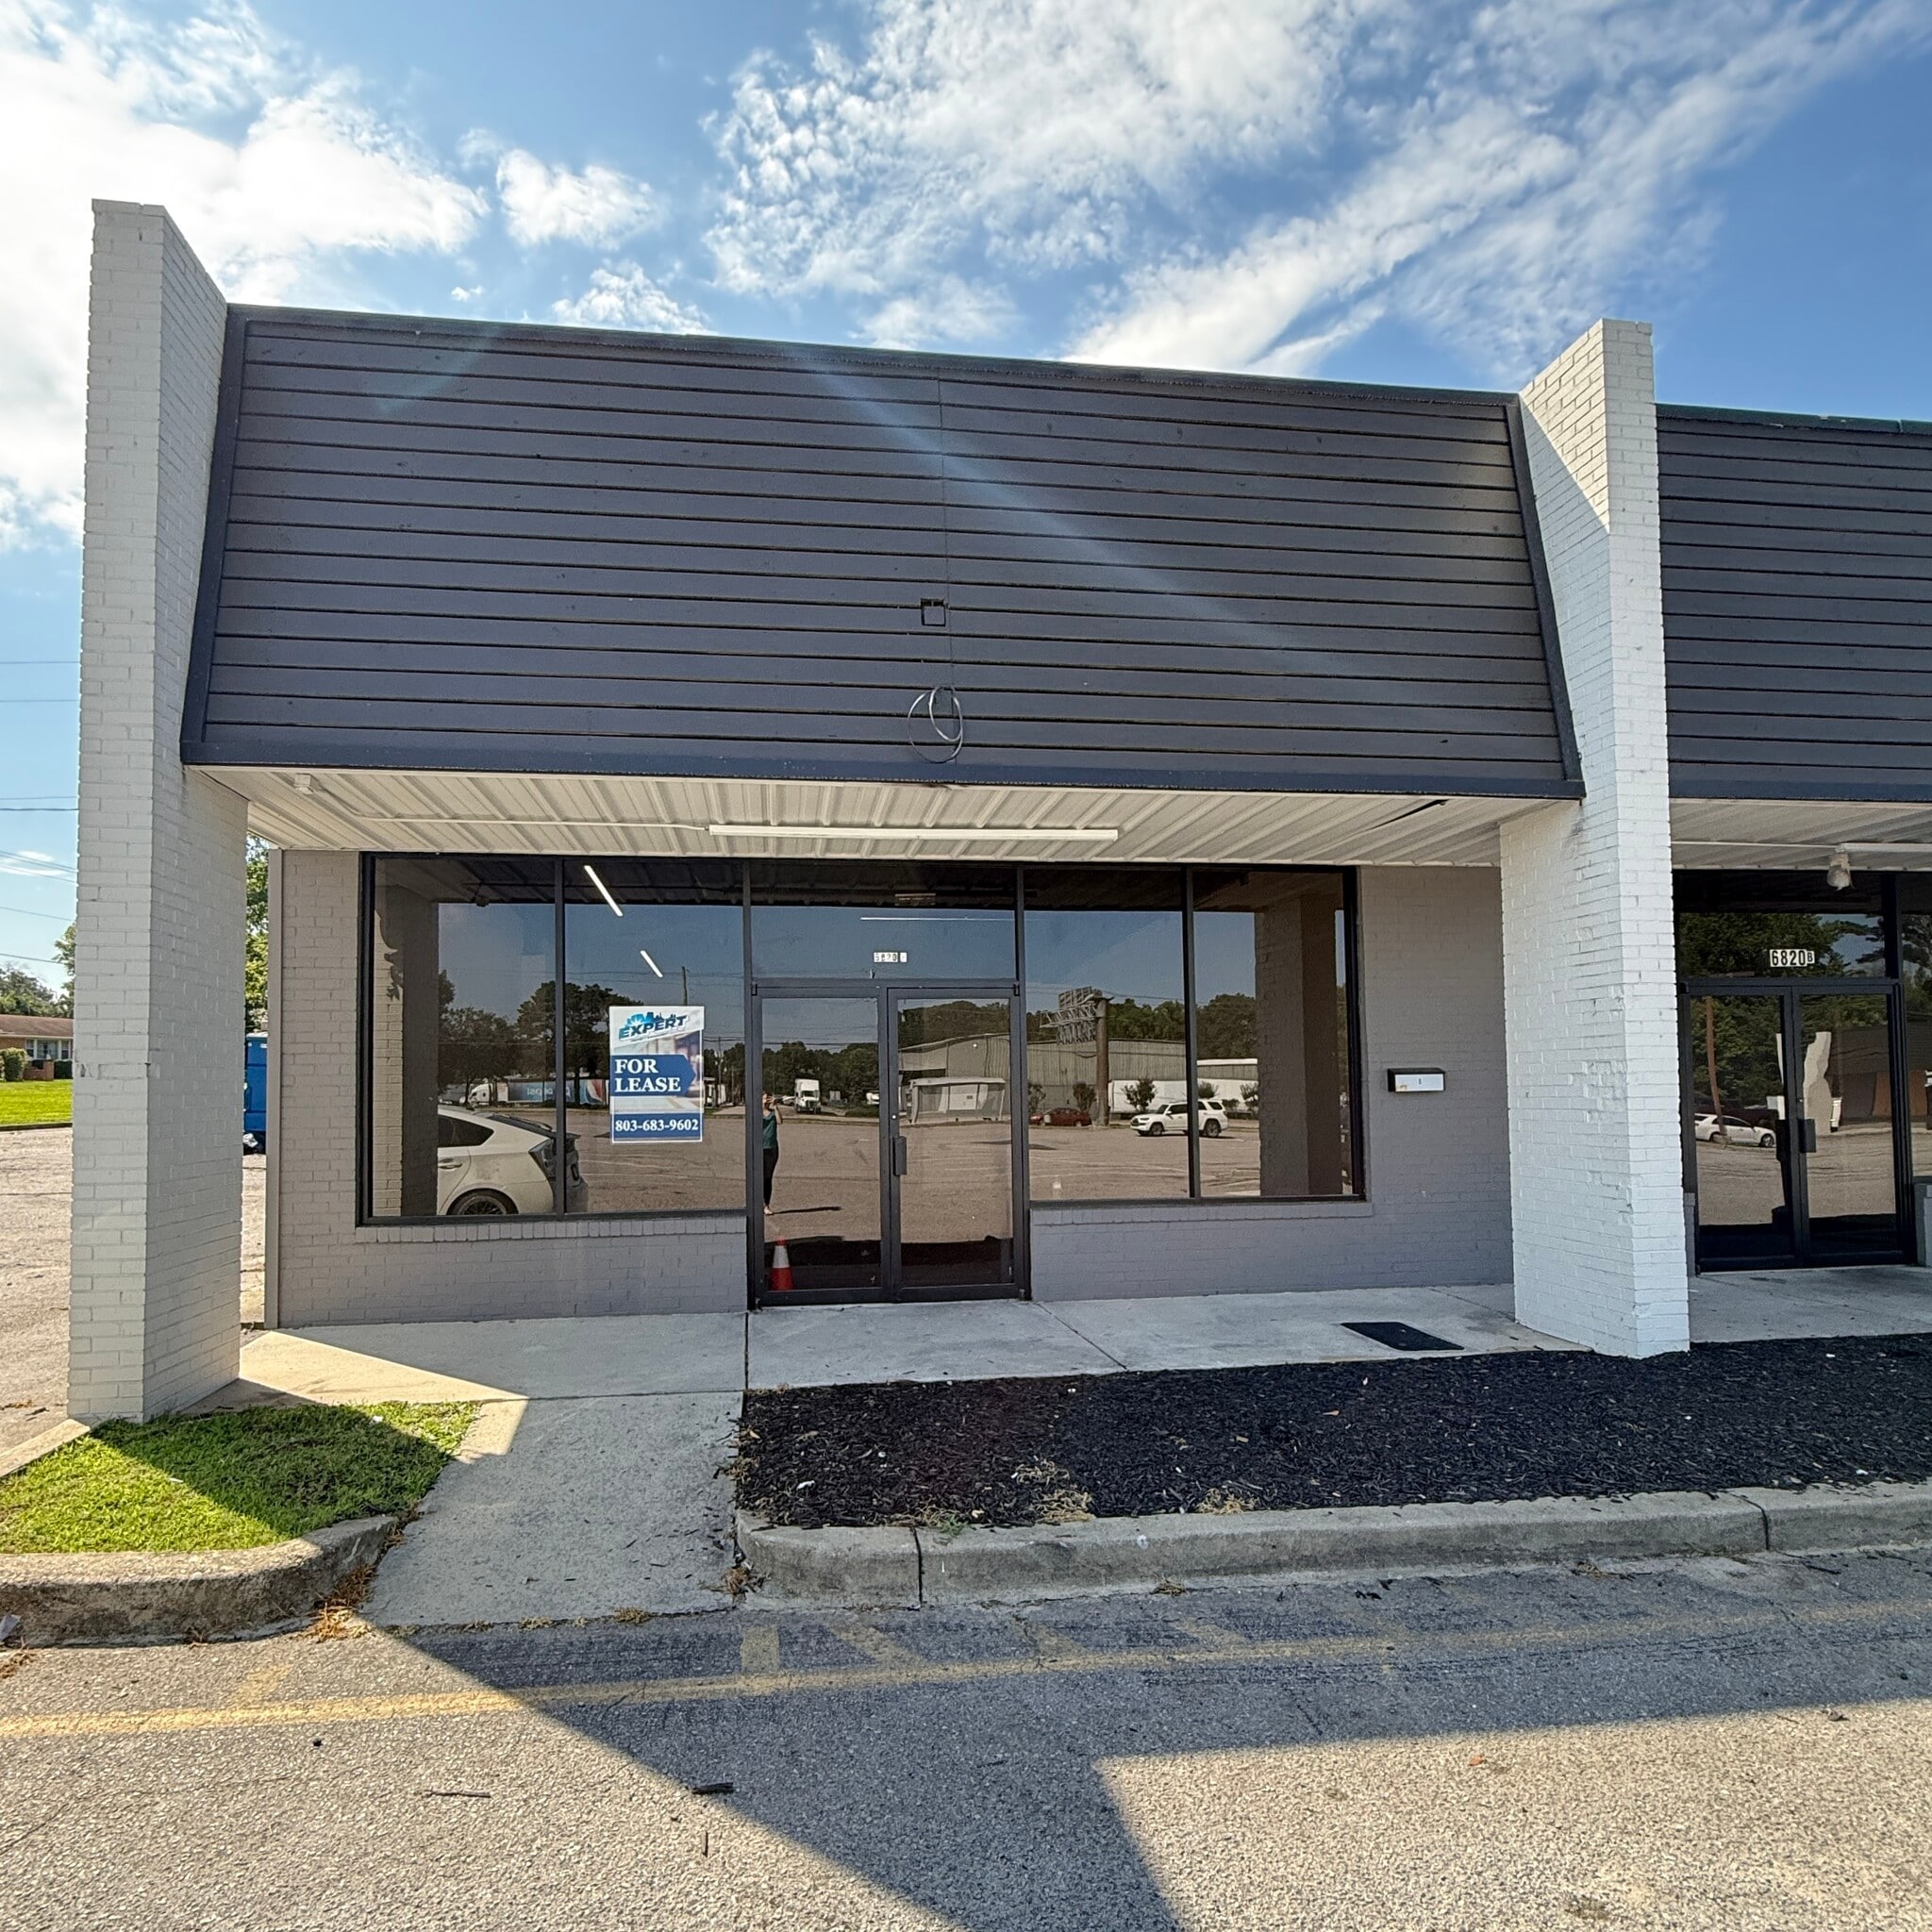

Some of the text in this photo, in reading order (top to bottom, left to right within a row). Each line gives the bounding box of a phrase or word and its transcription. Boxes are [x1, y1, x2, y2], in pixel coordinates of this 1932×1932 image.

[619, 1015, 687, 1040] EXPERT
[614, 1058, 658, 1074] FOR
[614, 1076, 681, 1092] LEASE
[615, 1119, 699, 1132] 803-683-9602
